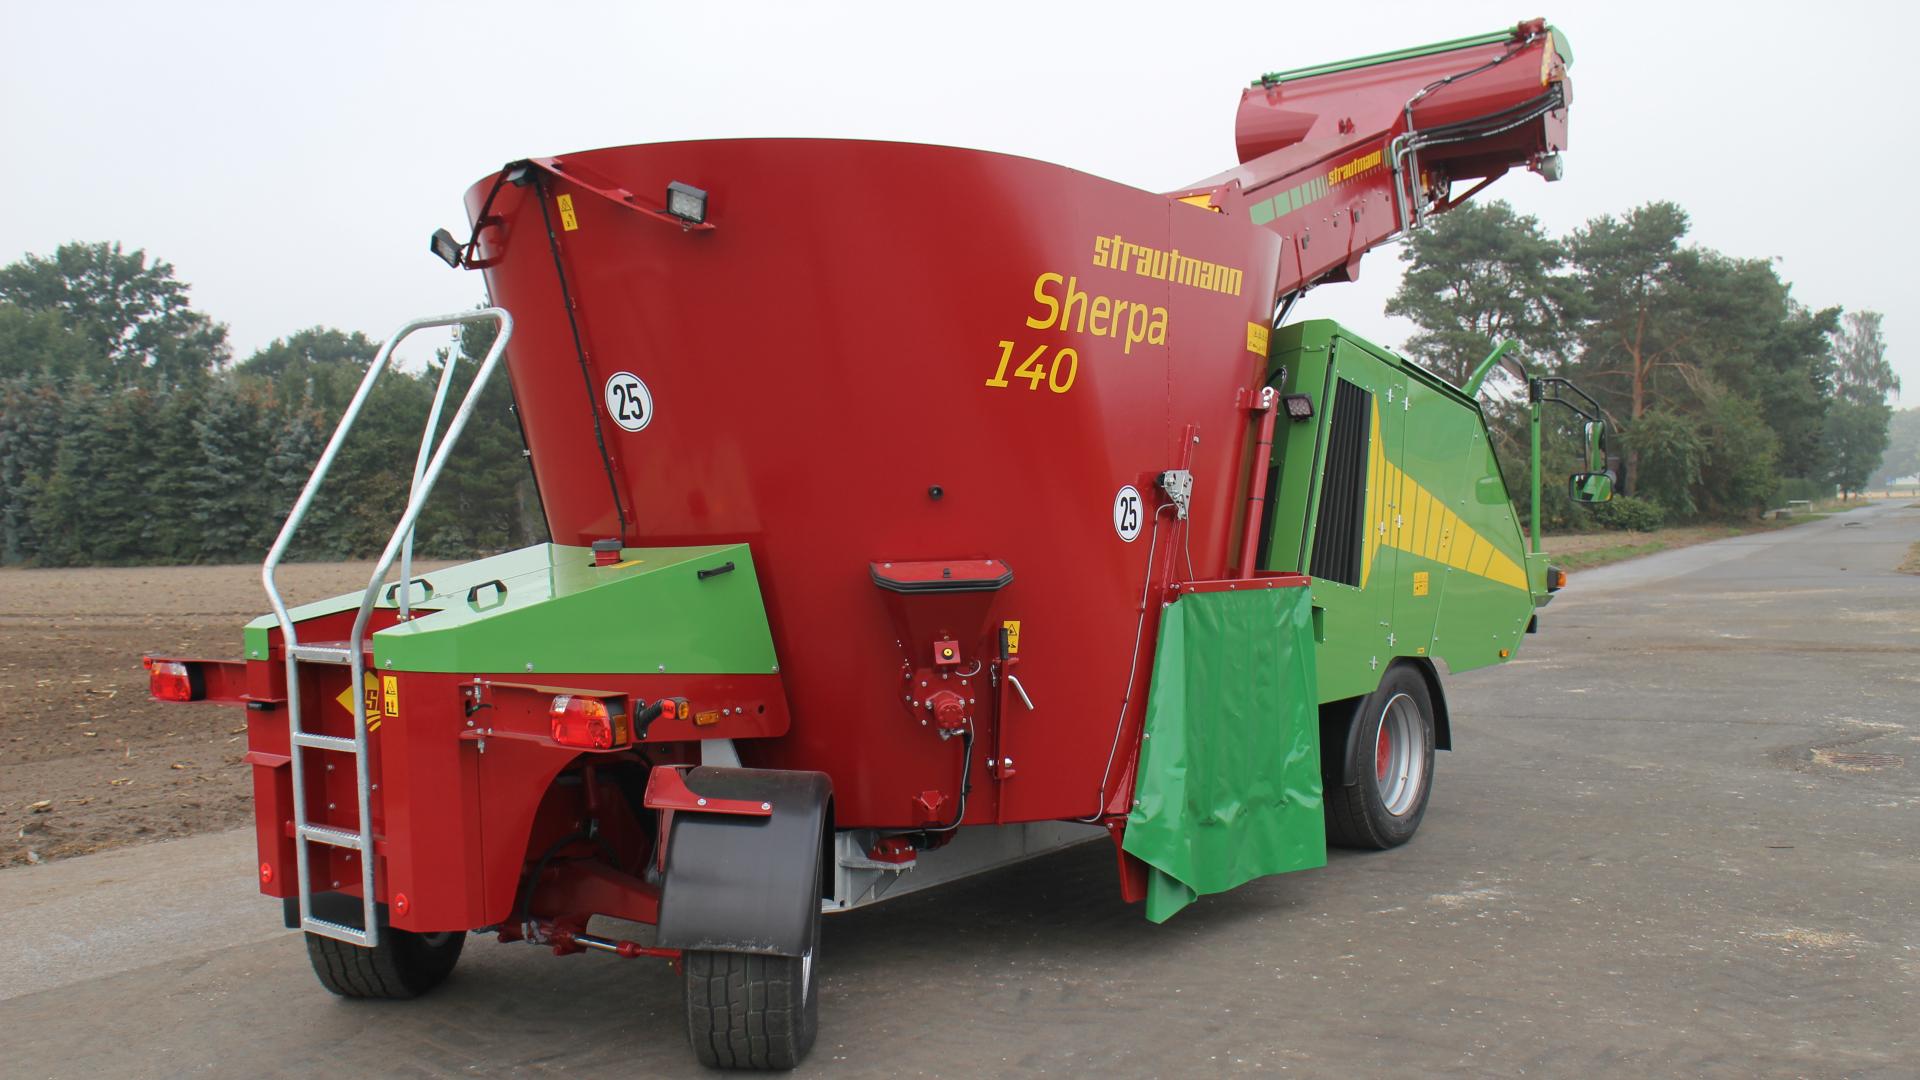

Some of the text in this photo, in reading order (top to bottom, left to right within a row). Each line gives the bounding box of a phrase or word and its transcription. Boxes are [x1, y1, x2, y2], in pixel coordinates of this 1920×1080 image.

[1328, 150, 1380, 187] strautmann
[1093, 234, 1243, 296] strautmann
[1025, 272, 1168, 354] Sherpa
[985, 340, 1078, 393] 140
[613, 383, 644, 420] 25
[1120, 496, 1137, 530] 25
